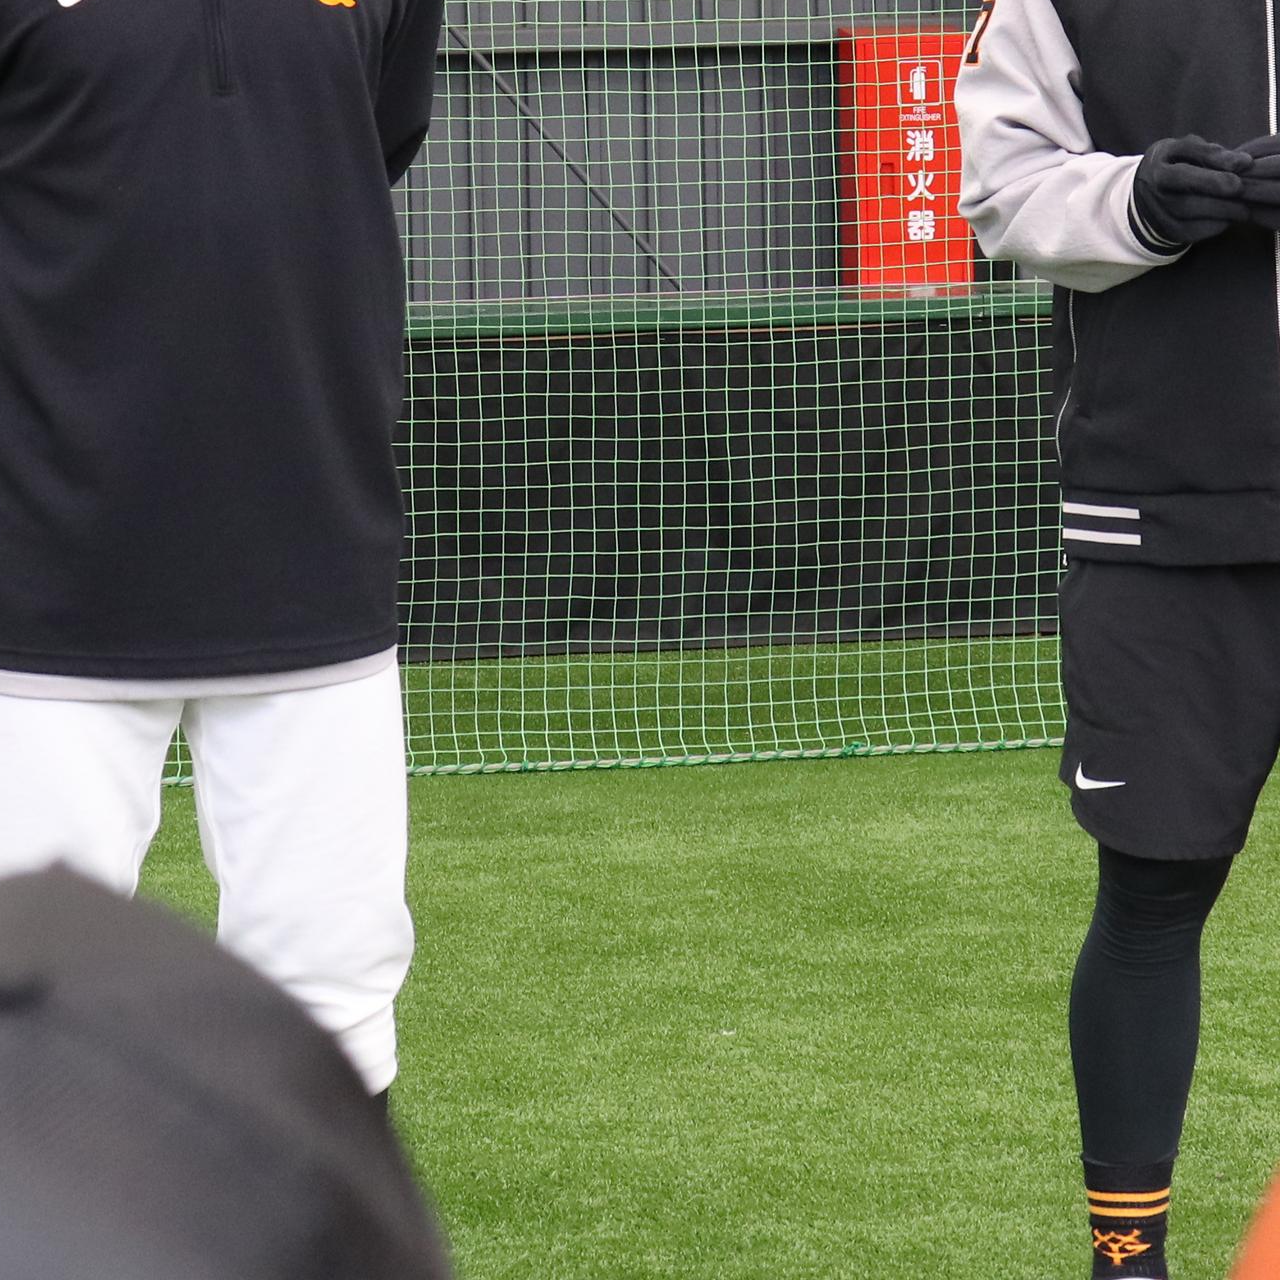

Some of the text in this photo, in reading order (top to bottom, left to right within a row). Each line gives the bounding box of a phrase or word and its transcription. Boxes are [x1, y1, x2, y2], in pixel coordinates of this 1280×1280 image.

[912, 106, 927, 114] FIRE
[906, 129, 936, 241] 消火器
